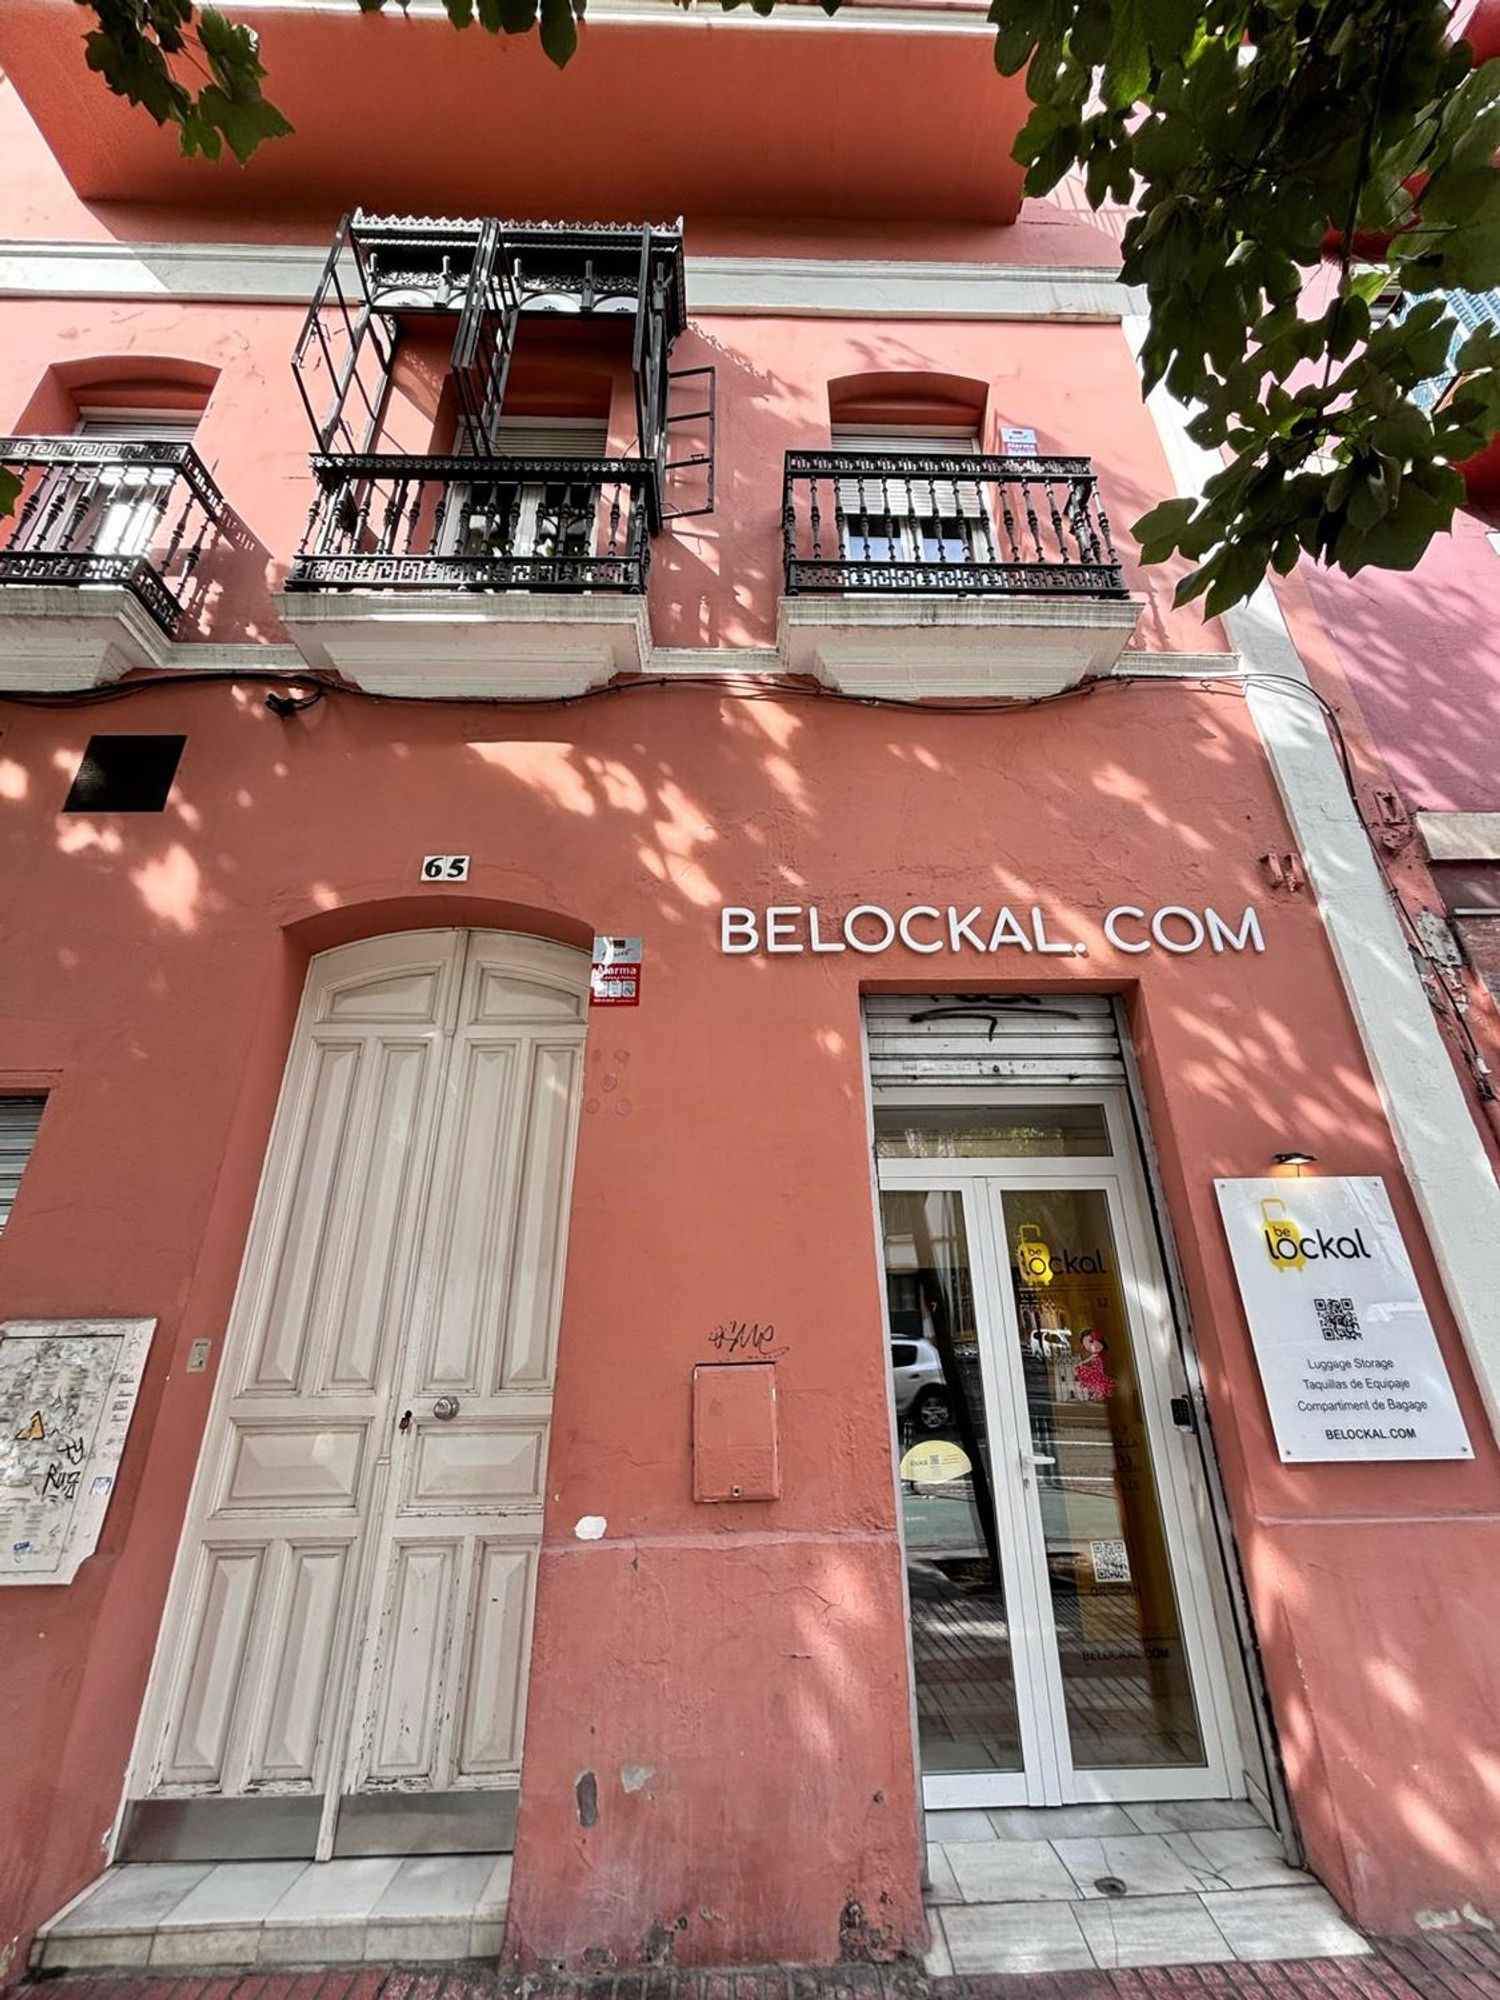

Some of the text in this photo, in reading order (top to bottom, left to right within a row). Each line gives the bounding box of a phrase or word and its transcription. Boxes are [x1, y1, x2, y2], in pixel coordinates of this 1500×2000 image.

[424, 857, 466, 878] 65
[1272, 1226, 1291, 1237] be
[1264, 1228, 1372, 1260] lockal
[1307, 1358, 1394, 1371] Luggage Storage
[1302, 1378, 1411, 1391] Taquillas de Equipaje
[1297, 1398, 1428, 1413] Compartiment de Bagage
[1325, 1428, 1417, 1440] BELOCKAL.COM
